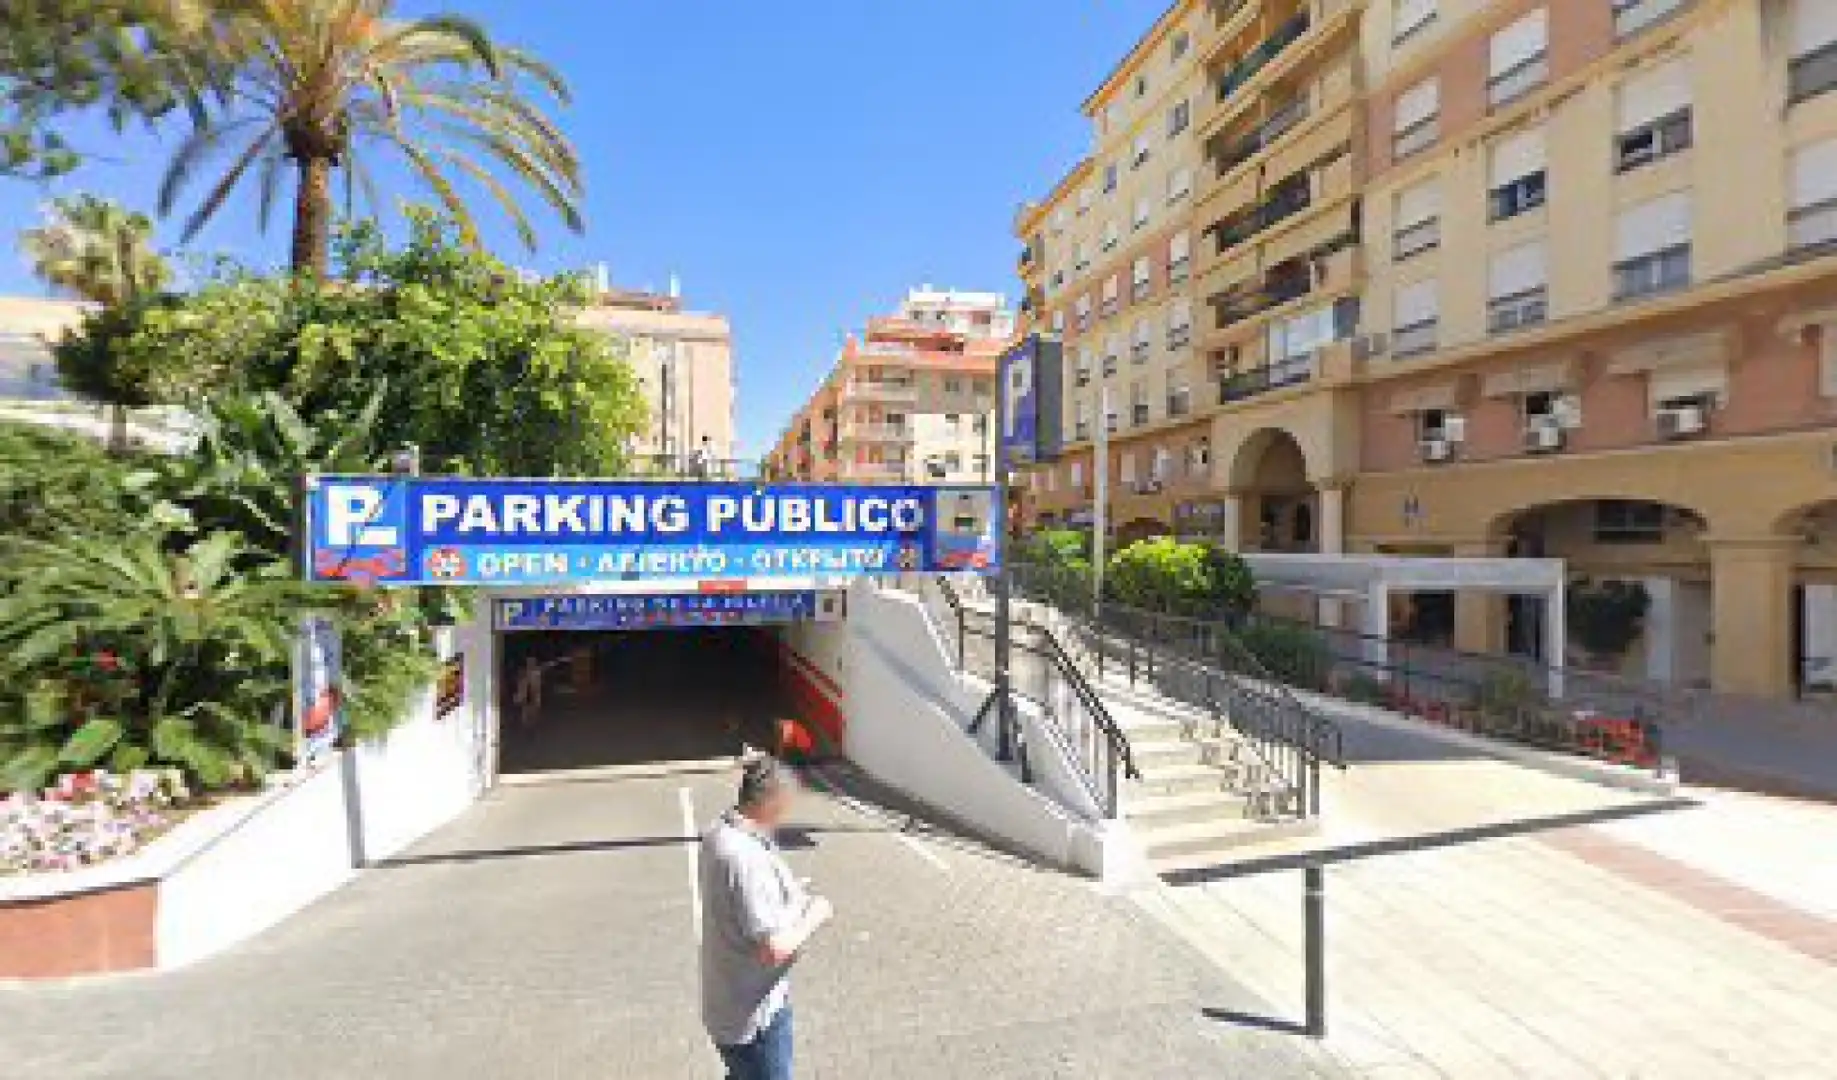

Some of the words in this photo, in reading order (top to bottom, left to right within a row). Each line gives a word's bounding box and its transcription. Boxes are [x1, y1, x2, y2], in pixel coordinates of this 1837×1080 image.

[1003, 356, 1032, 437] P
[422, 494, 690, 533] PARKING
[706, 488, 924, 533] PÚBLICO
[477, 552, 569, 574] OPEN
